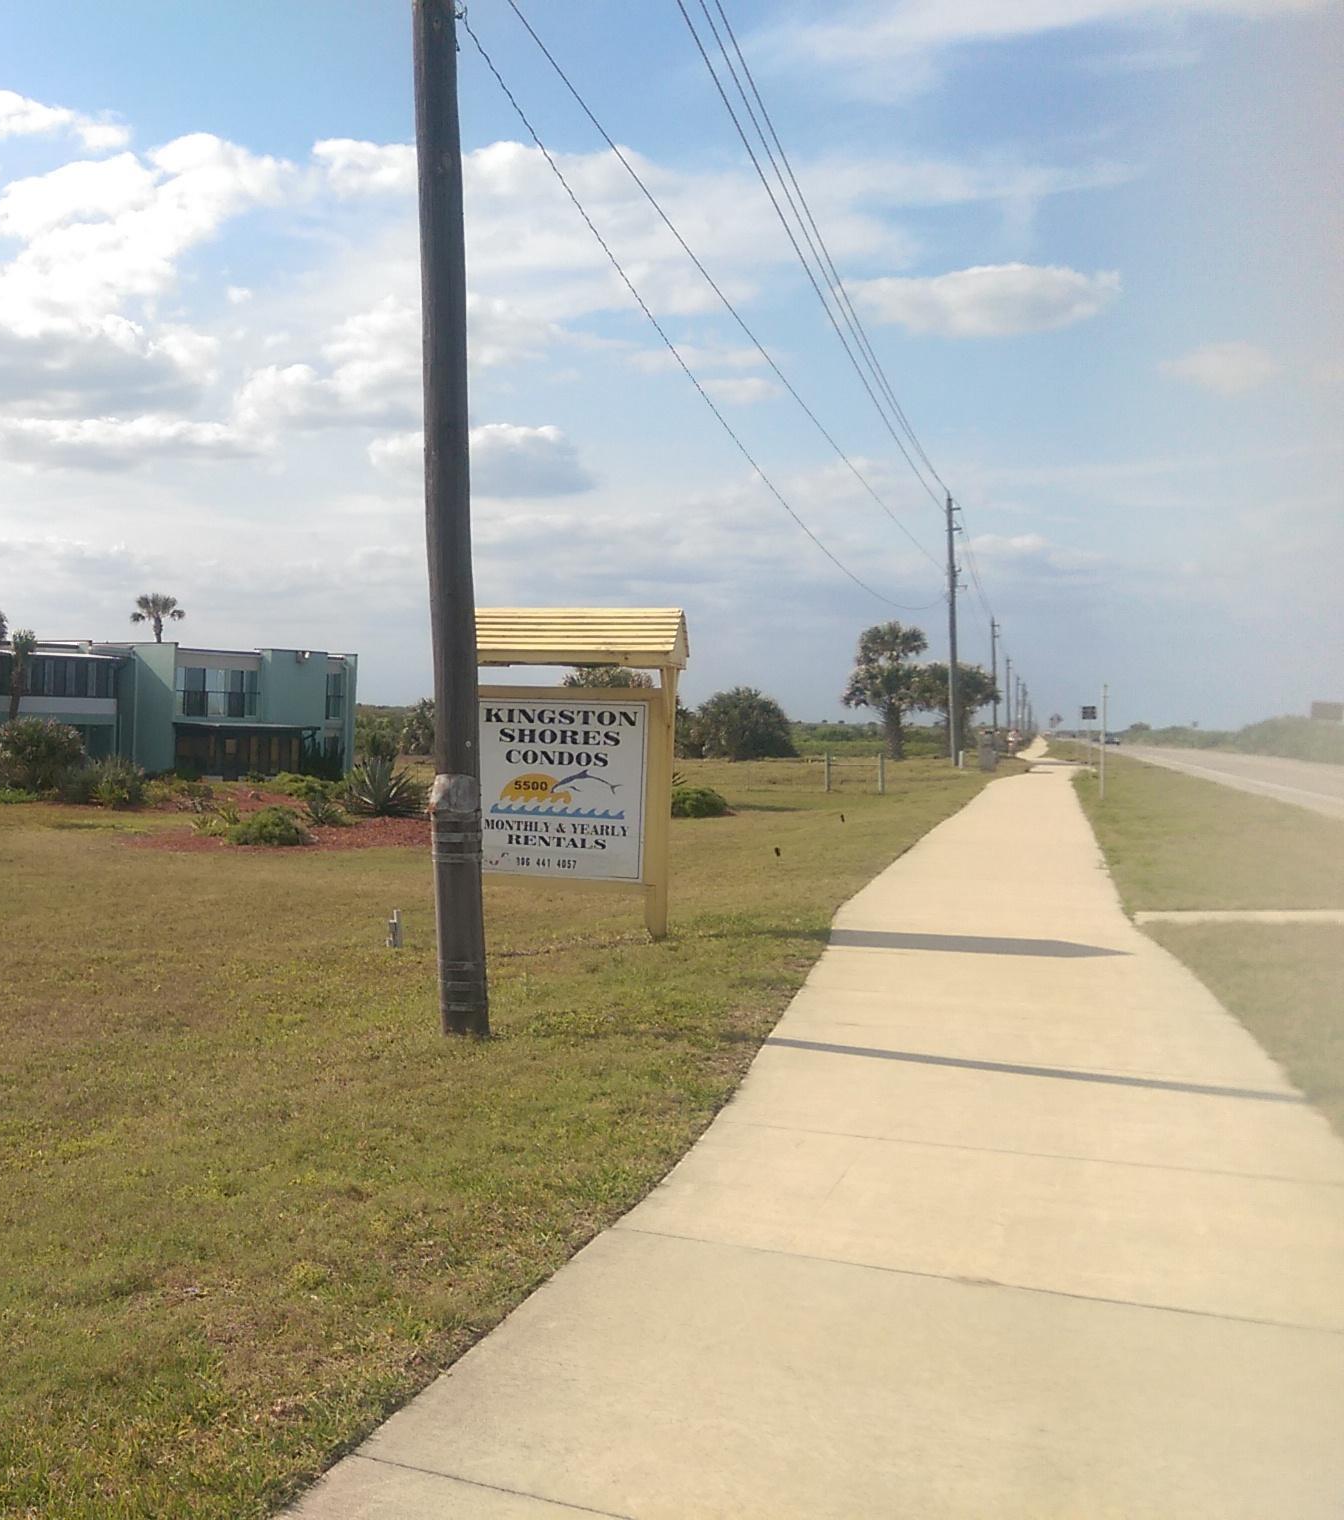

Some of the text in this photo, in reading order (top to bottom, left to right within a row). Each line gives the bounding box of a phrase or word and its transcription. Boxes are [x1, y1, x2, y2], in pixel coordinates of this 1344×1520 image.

[484, 707, 638, 727] KINGSTON
[499, 728, 621, 747] SHORES
[505, 749, 609, 768] CONDOS
[514, 780, 548, 791] 5500
[484, 819, 629, 837] MONTHLY & YEARLY
[507, 835, 607, 850] RENTALS
